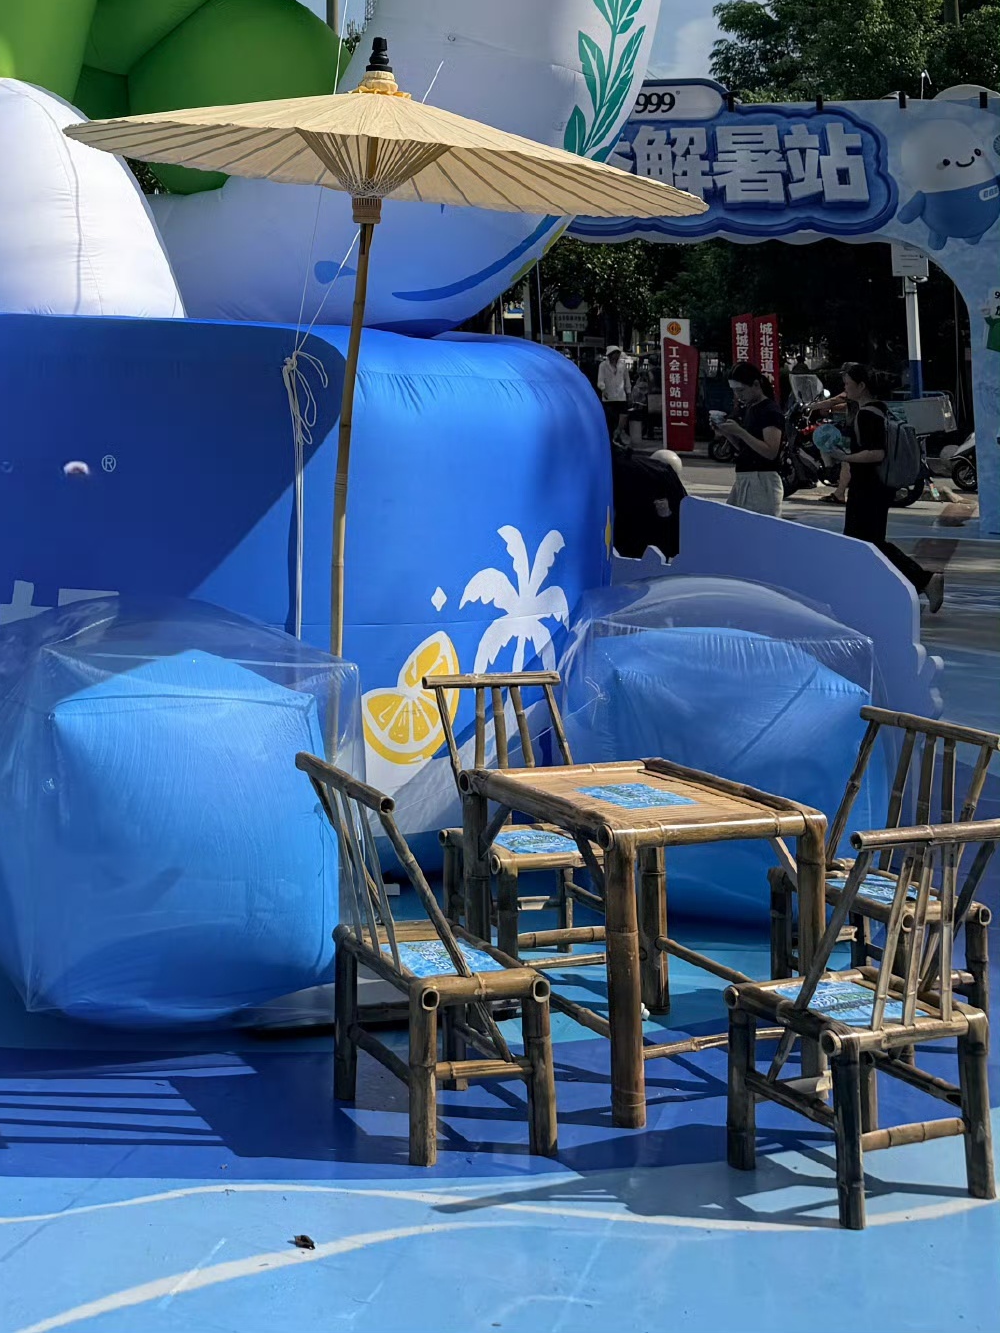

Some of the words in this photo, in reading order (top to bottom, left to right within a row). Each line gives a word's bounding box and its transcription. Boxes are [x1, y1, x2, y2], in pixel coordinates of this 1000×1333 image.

[607, 122, 870, 204] 解暑站
[735, 322, 749, 363] 鹤城区
[668, 346, 682, 398] 工会驿站
